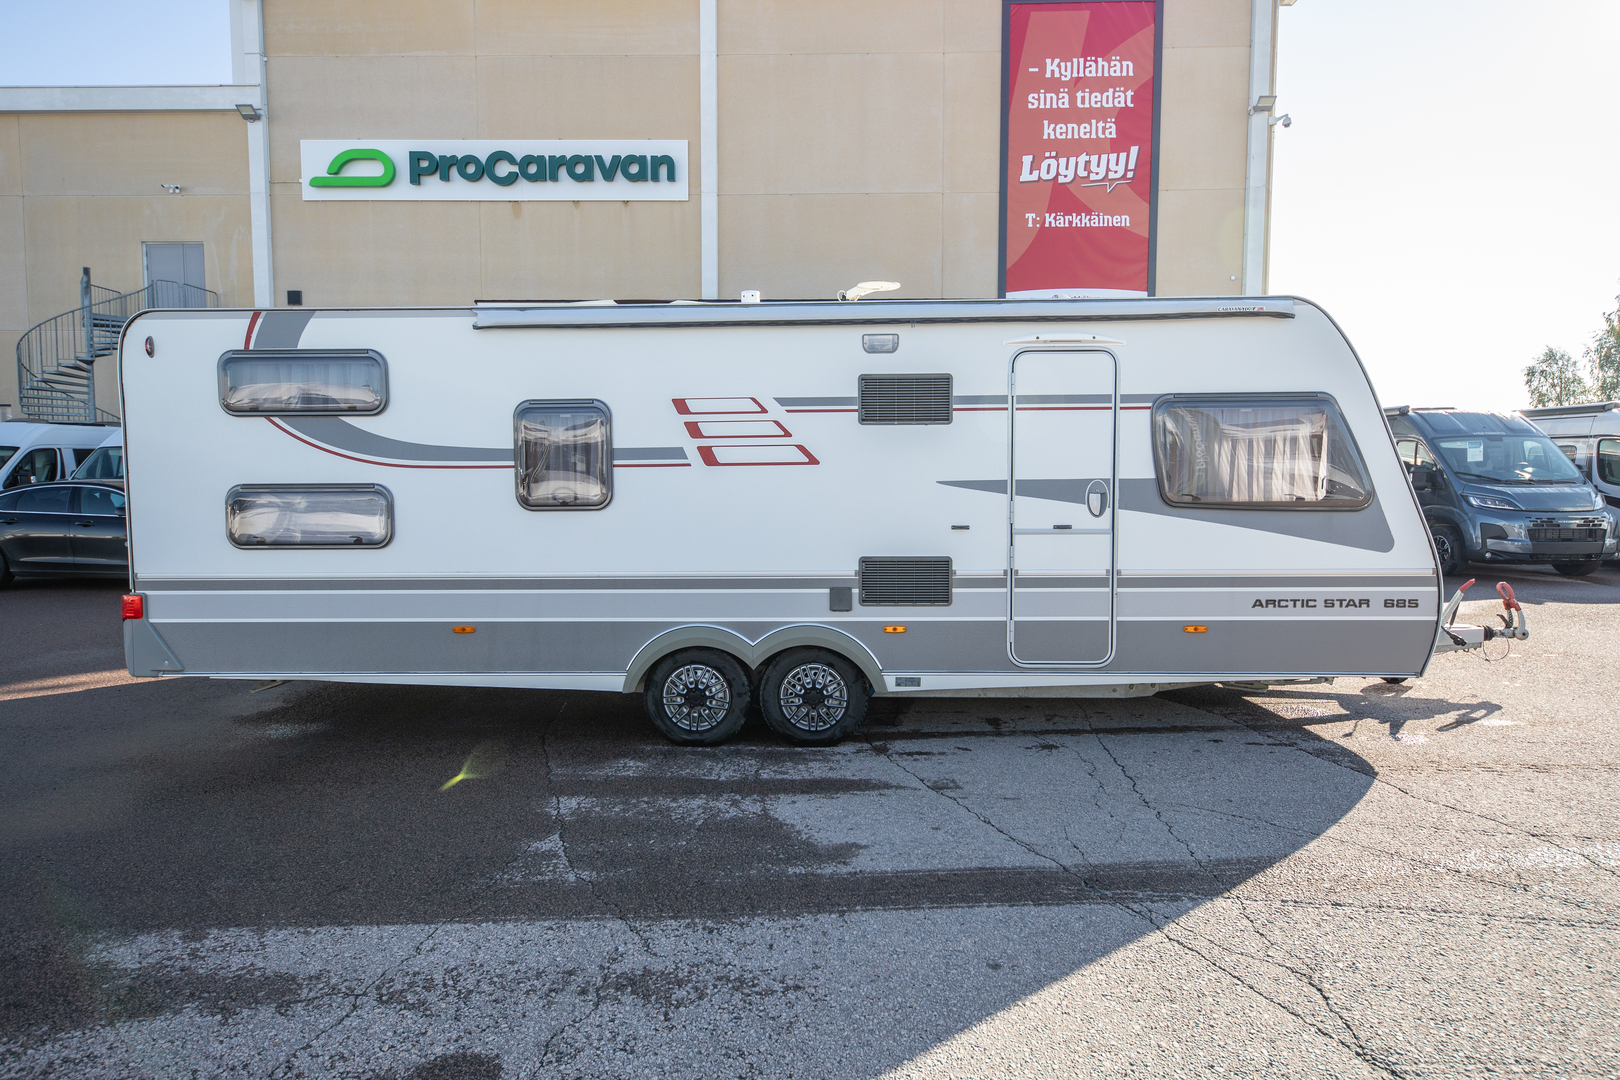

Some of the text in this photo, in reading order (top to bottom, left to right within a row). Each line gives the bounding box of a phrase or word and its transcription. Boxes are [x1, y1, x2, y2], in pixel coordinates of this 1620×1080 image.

[1045, 56, 1134, 81] Kyllähän
[1027, 87, 1135, 109] sinä tiedät
[1042, 118, 1117, 140] keneltä
[408, 150, 676, 187] ProCaravan
[1019, 145, 1141, 184] Löytyy!
[1025, 212, 1131, 228] T: Kärkkäinen
[1251, 598, 1419, 609] ARCTIC STAR 685
